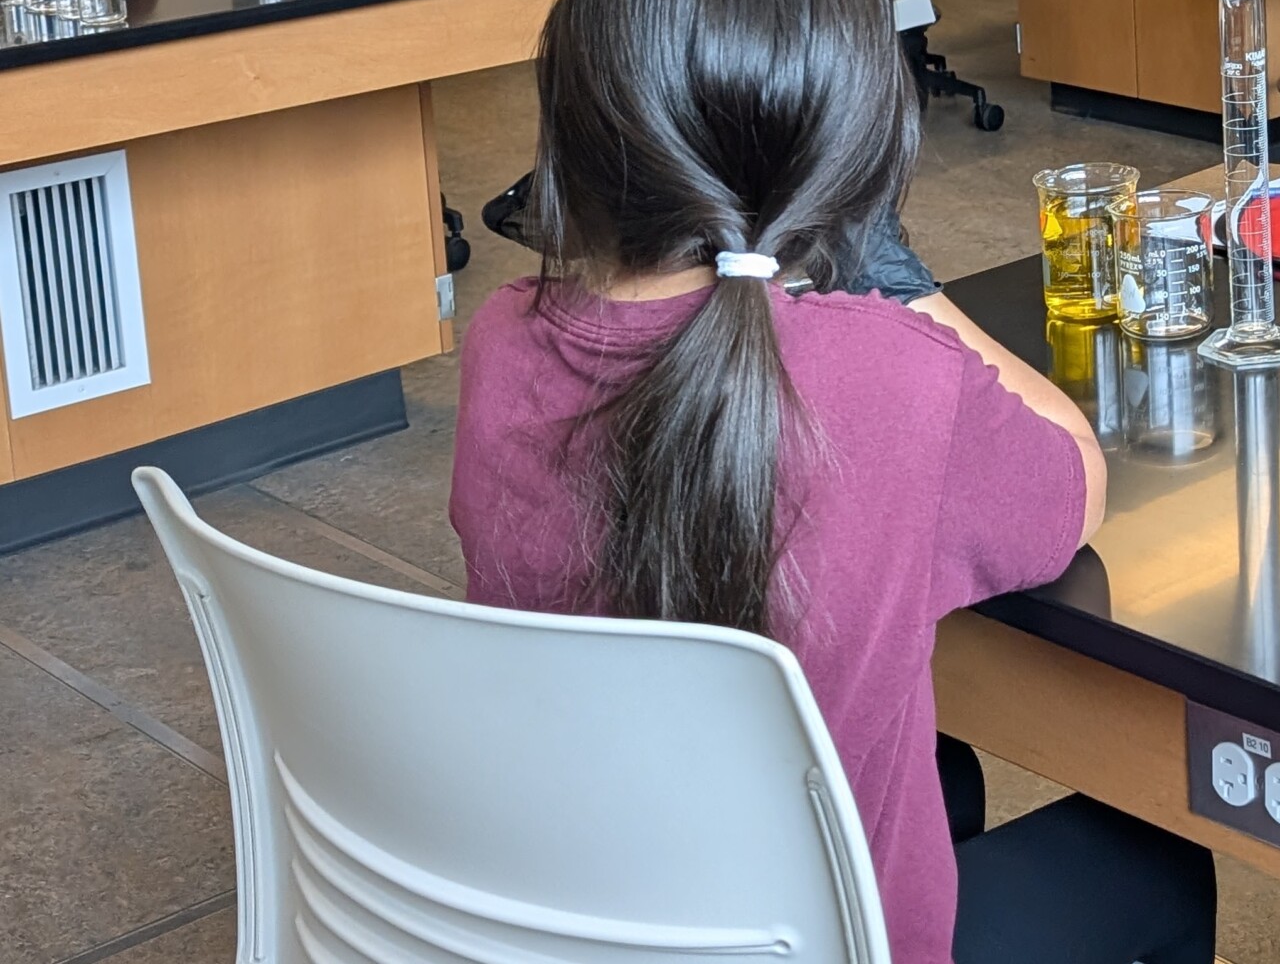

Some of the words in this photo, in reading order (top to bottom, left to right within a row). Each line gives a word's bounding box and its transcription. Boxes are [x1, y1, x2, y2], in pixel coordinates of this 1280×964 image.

[1186, 245, 1198, 255] 200
[1120, 250, 1141, 262] 250mL
[1188, 264, 1200, 273] 150
[1157, 270, 1167, 278] 50
[1190, 286, 1200, 294] 100
[1156, 314, 1170, 322] 150
